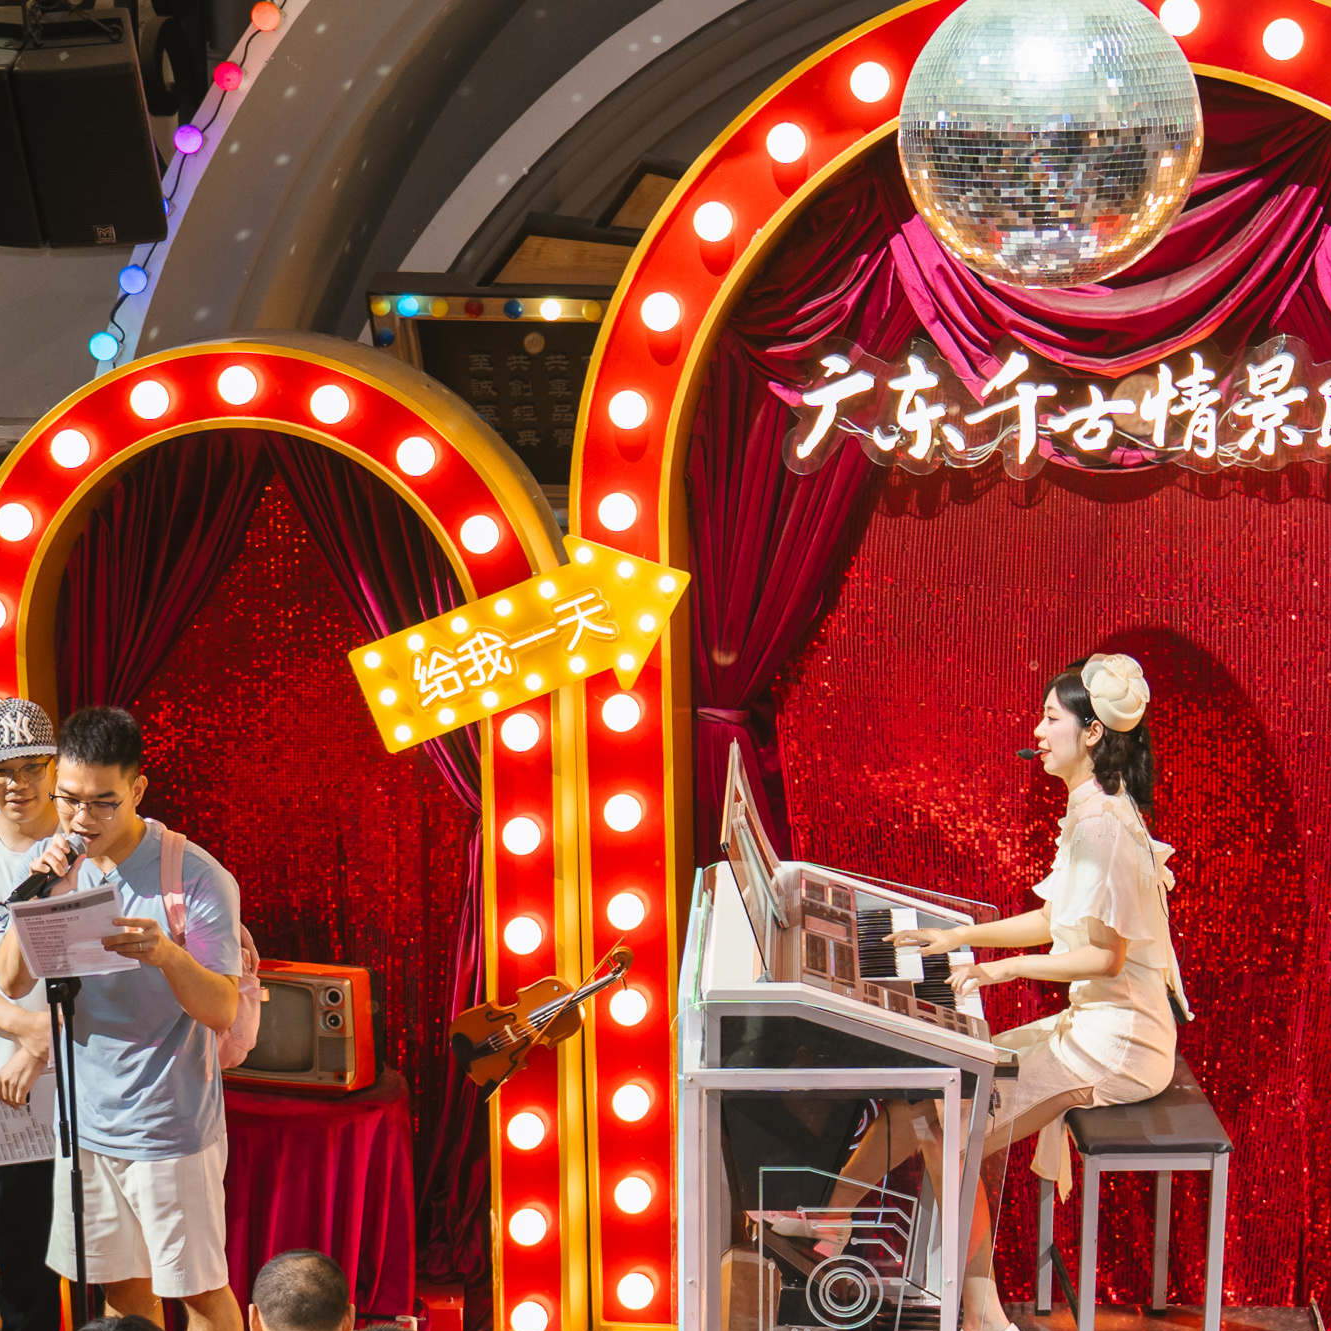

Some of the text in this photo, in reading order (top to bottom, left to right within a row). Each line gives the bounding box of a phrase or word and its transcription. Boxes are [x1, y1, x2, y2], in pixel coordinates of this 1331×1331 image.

[469, 354, 502, 435] 至誠至
[414, 592, 614, 707] 给我一天
